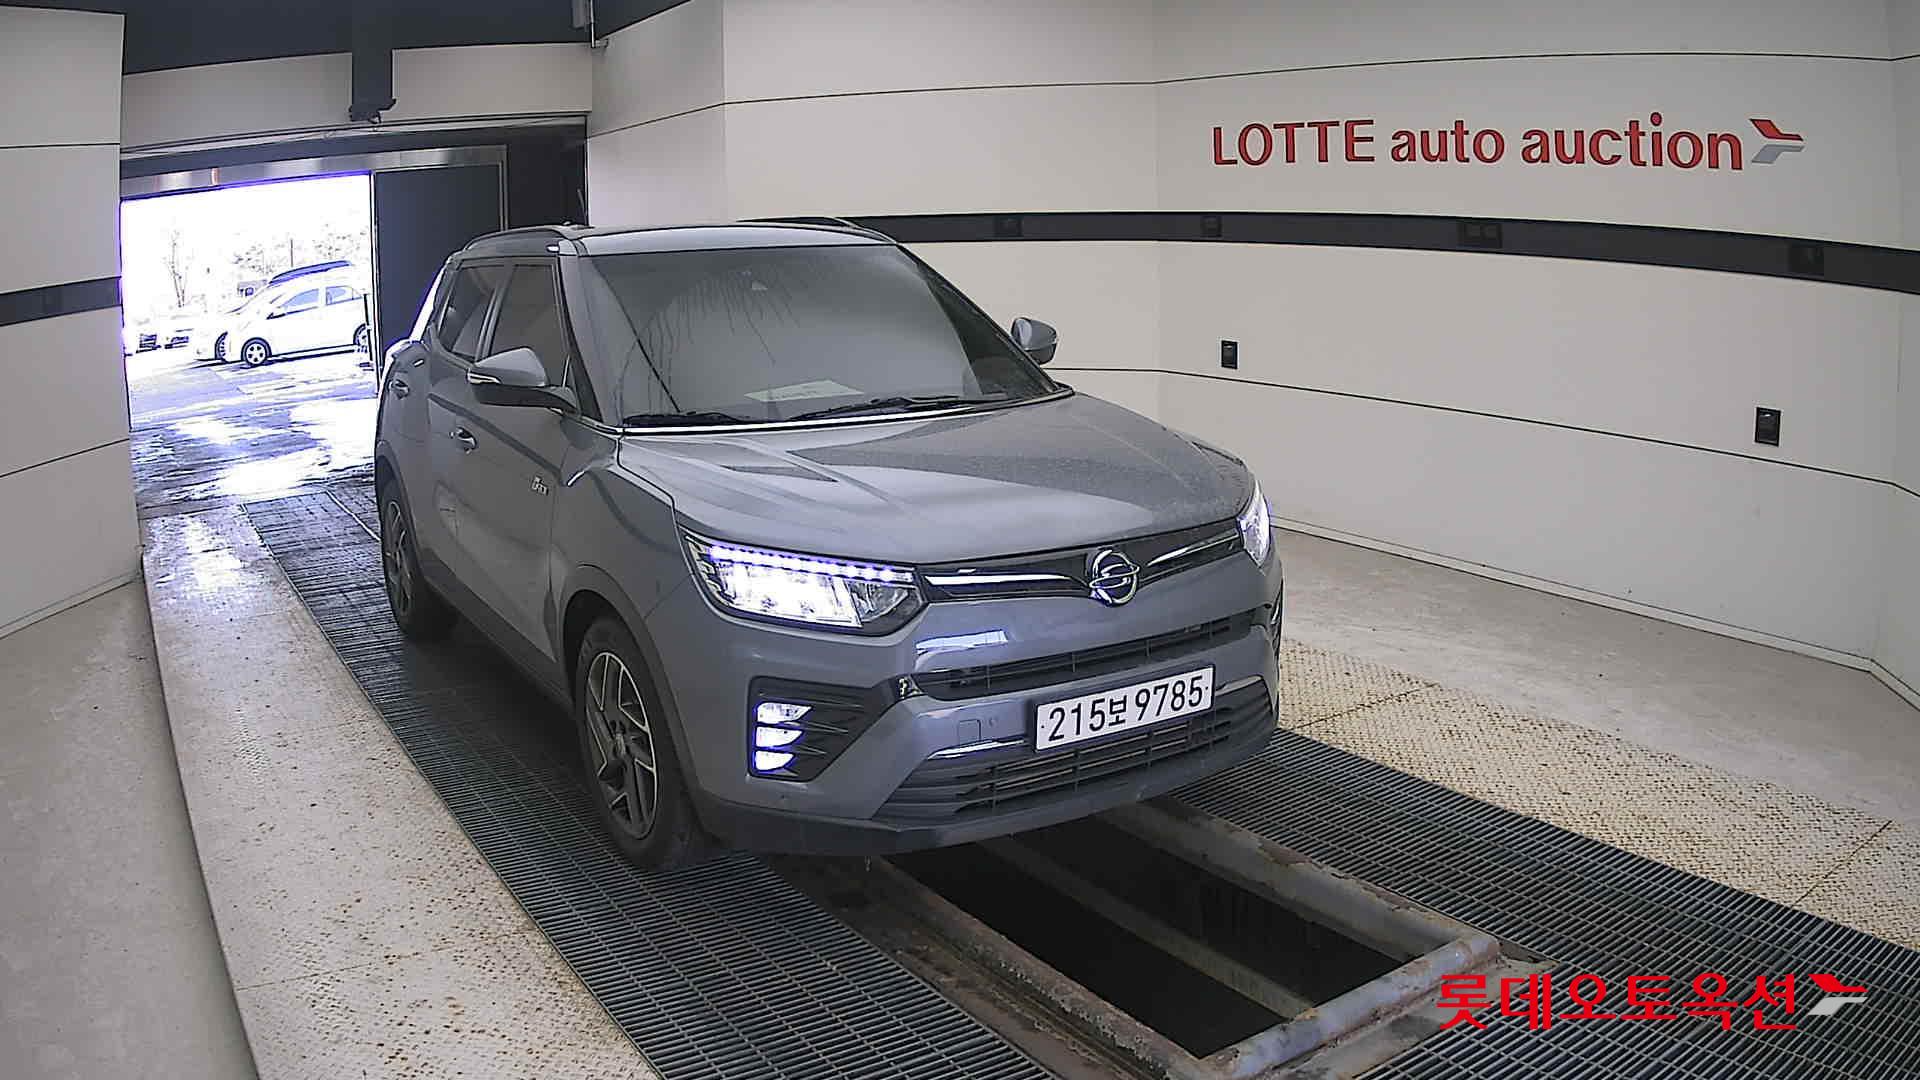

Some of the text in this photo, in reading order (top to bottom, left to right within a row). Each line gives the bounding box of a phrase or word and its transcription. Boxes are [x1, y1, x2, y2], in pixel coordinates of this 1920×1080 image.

[1212, 112, 1743, 171] LOTTE auto auction
